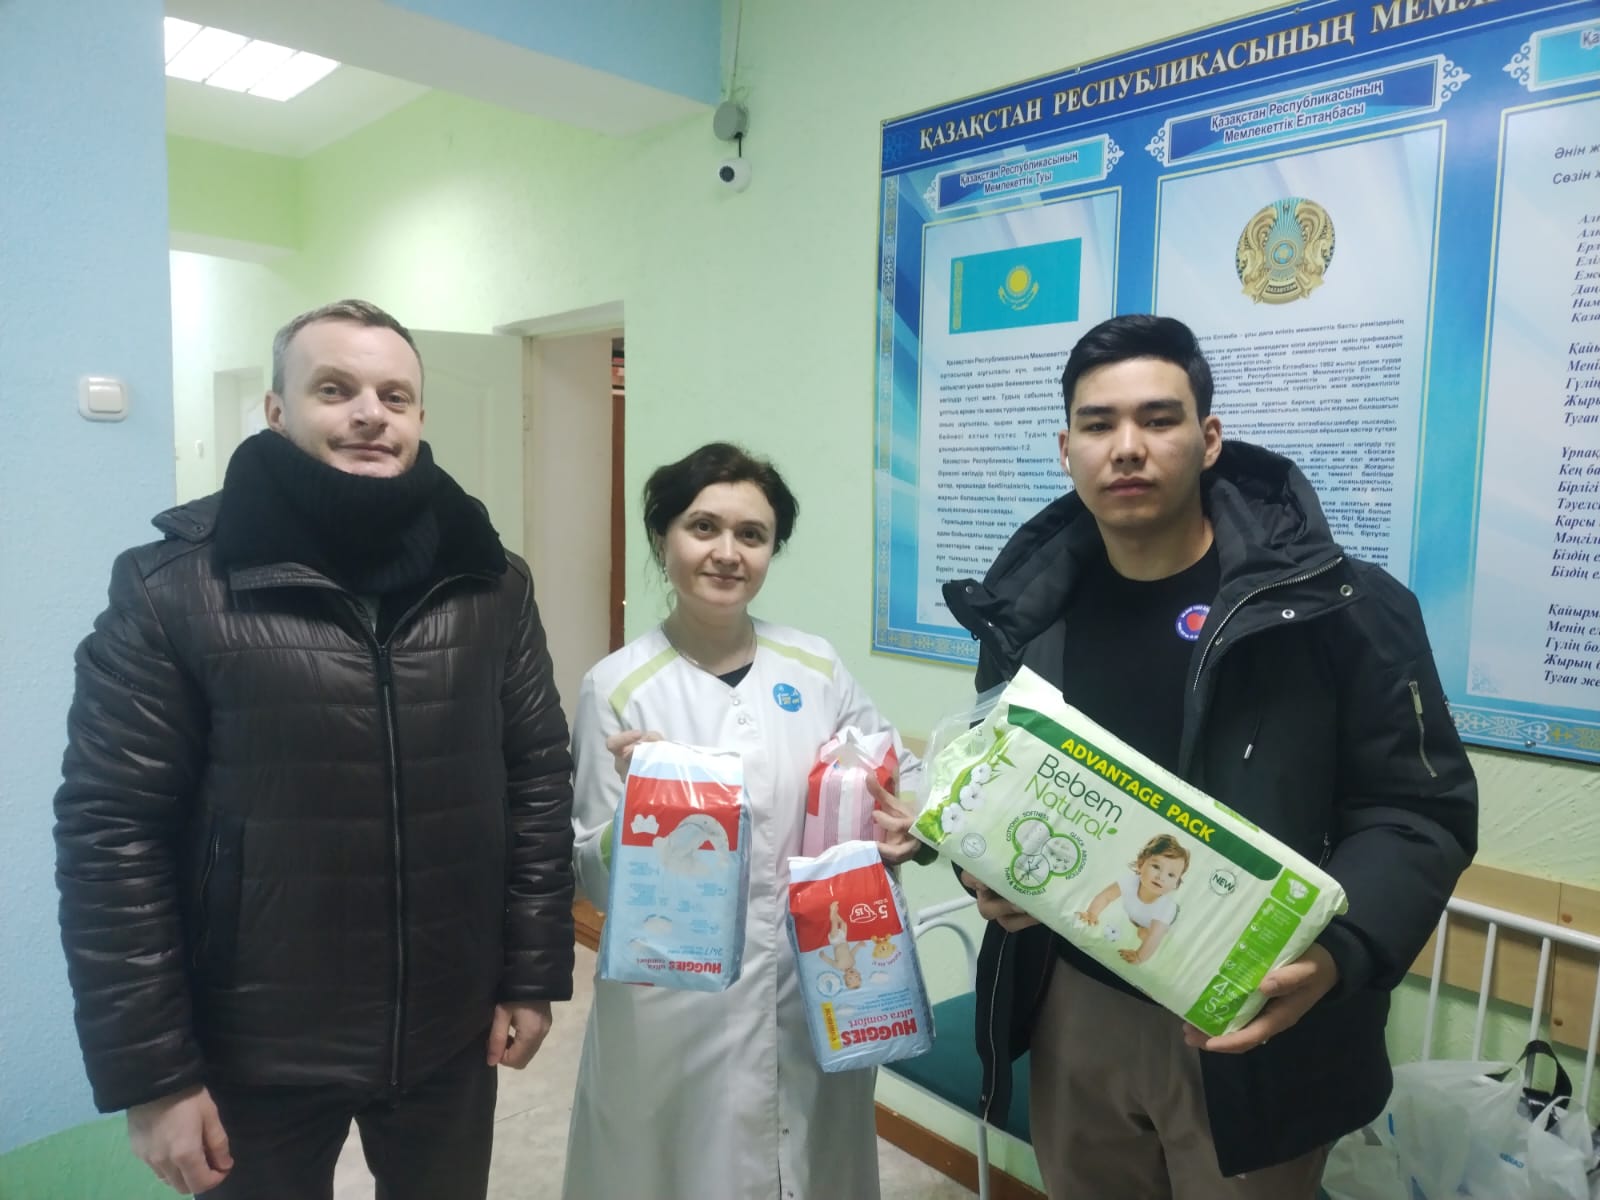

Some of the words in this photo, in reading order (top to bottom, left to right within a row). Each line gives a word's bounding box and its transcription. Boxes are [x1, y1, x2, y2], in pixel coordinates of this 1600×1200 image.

[919, 97, 1042, 151] ҚАЗАҚСТАН
[1053, 12, 1356, 116] РЕСПУБЛИКАСЫНЫҢ
[1212, 108, 1266, 131] Қазақстан
[1269, 80, 1384, 117] Республикасының
[1224, 121, 1294, 143] Мемлекеттік
[1296, 102, 1365, 128] Елтаңбасы
[1037, 753, 1123, 824] Bebem
[1060, 737, 1164, 810] ADVANTAGE
[1166, 803, 1216, 843] PACK
[1024, 774, 1102, 841] Natural
[1212, 872, 1236, 892] NEW
[878, 904, 888, 919] 5
[668, 961, 722, 974] HUGGIES
[1212, 981, 1230, 997] 4
[847, 1012, 889, 1028] comfort
[893, 1008, 914, 1022] ultra
[840, 1017, 918, 1048] HUGGIES
